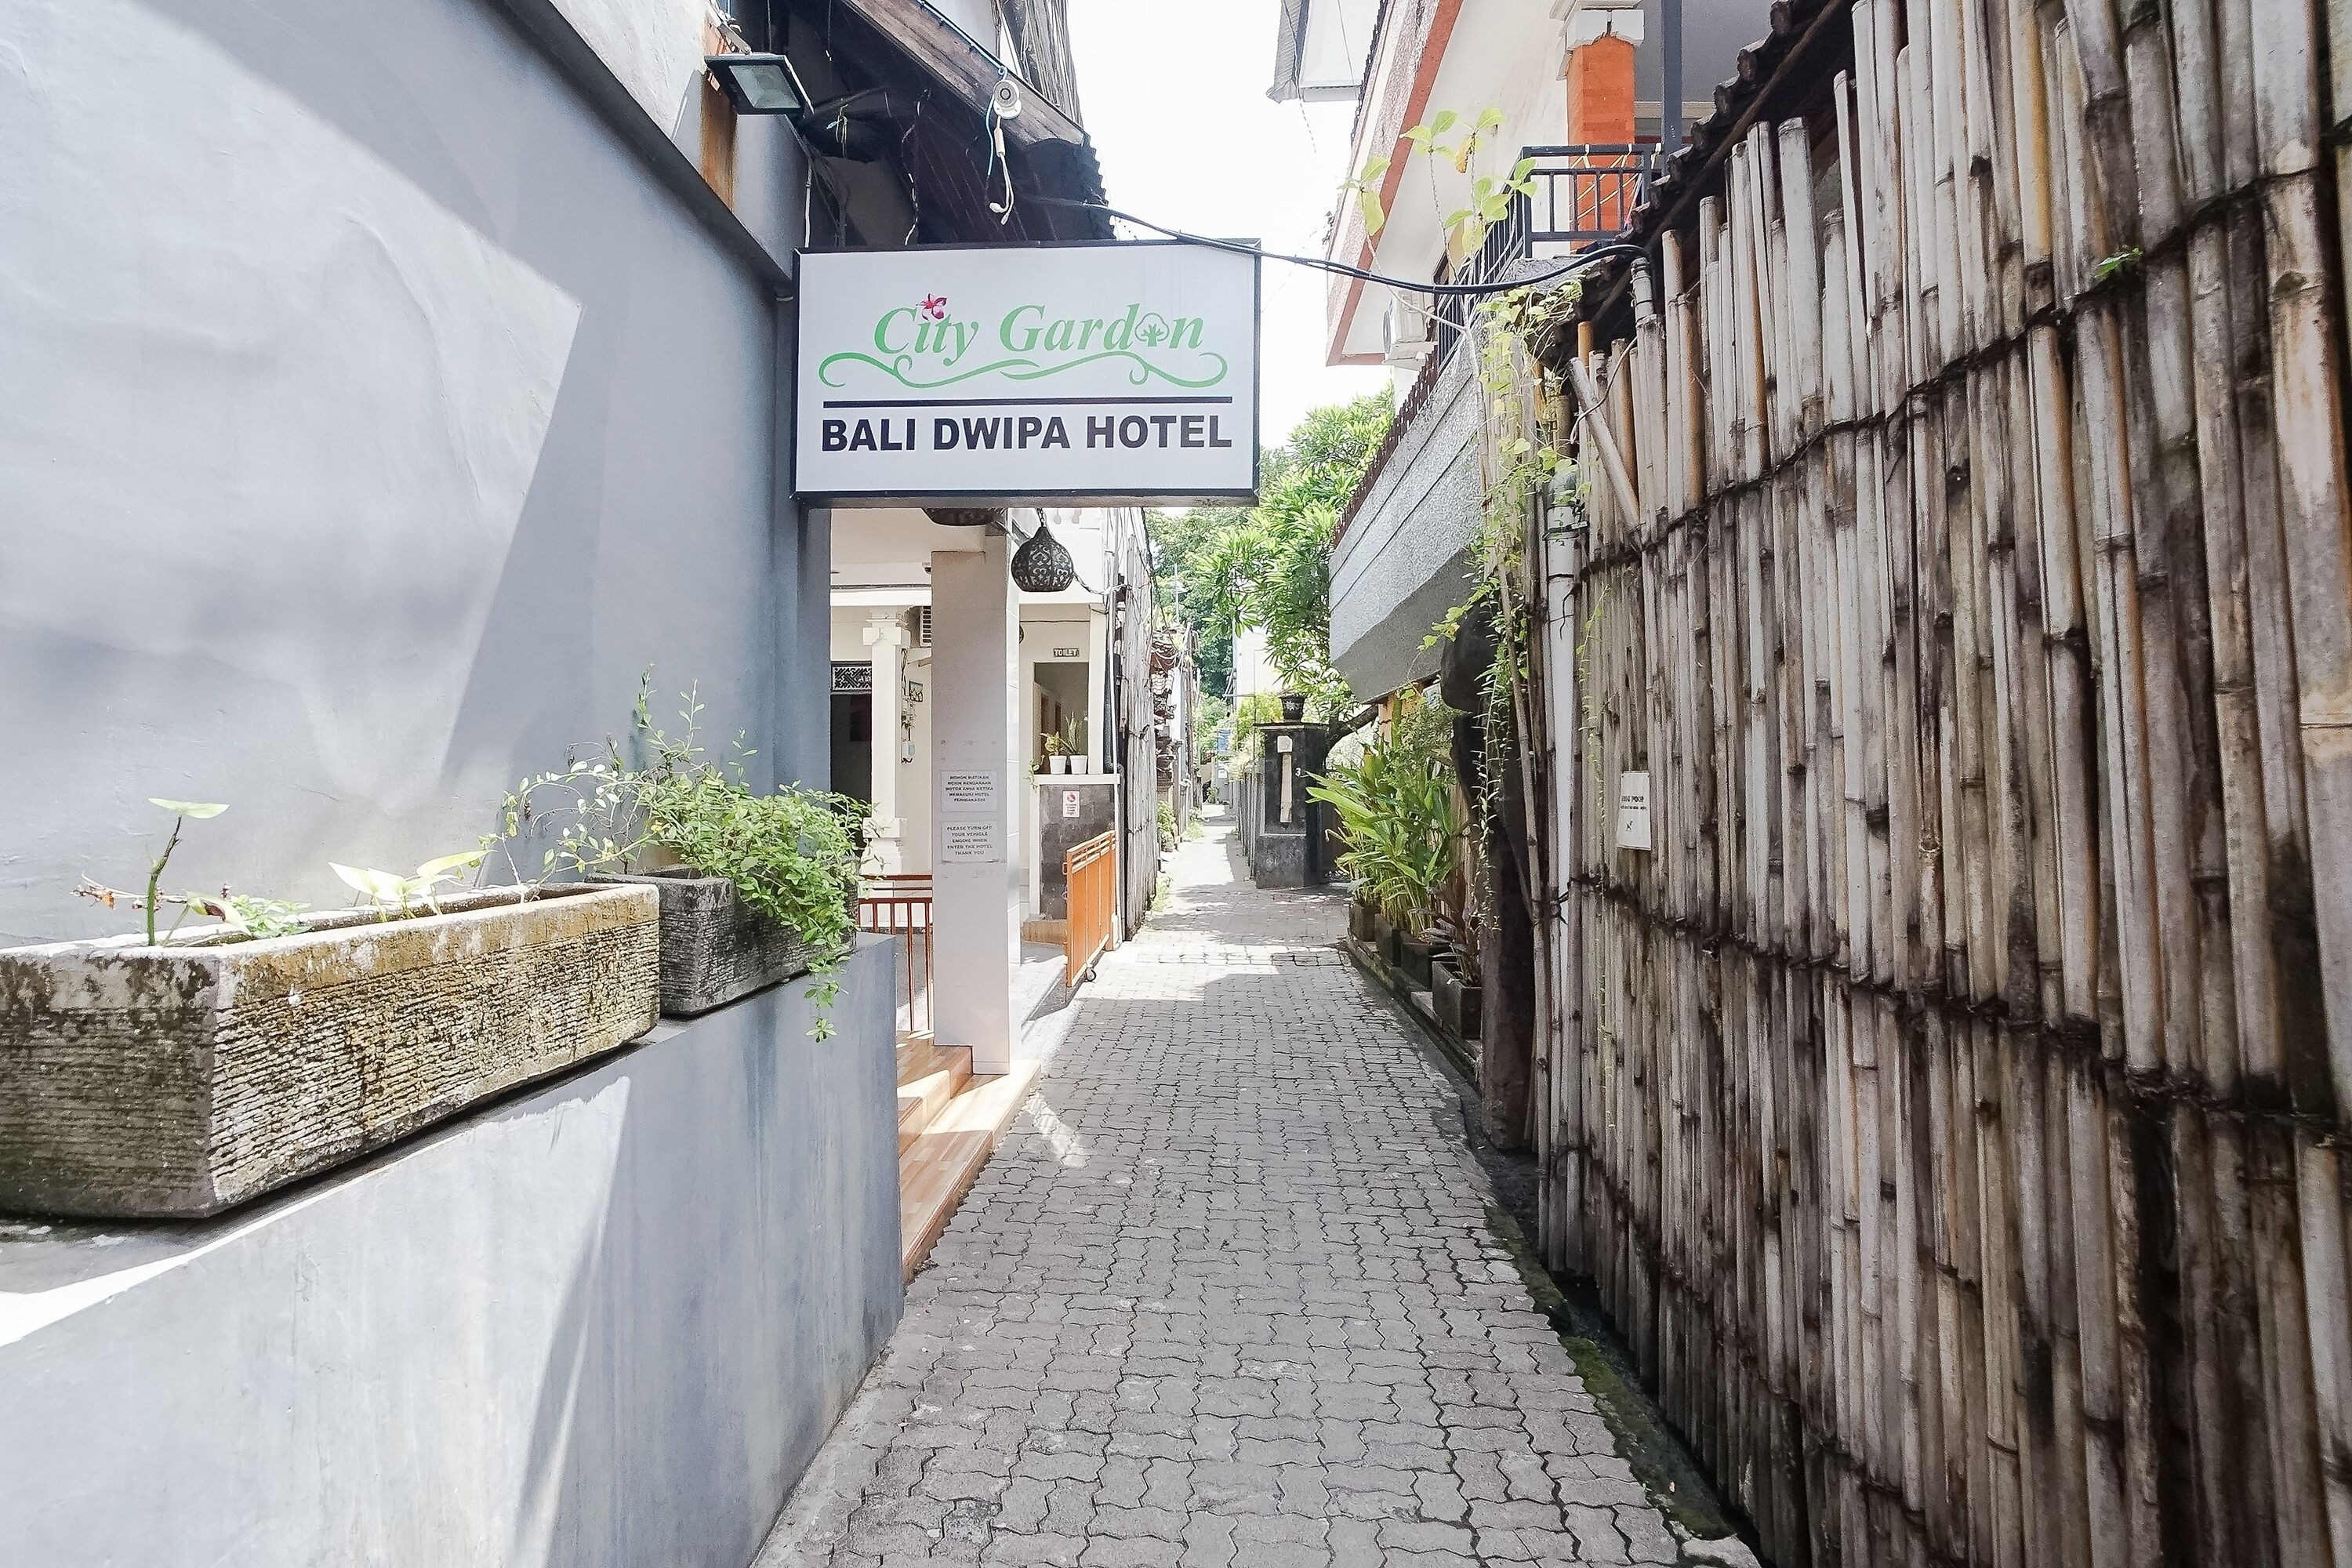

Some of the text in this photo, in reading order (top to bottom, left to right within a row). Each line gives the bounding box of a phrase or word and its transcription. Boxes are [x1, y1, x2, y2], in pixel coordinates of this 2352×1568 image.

[873, 303, 1204, 366] City Gardn
[822, 415, 1232, 452] BALI DWIPA HOTEL
